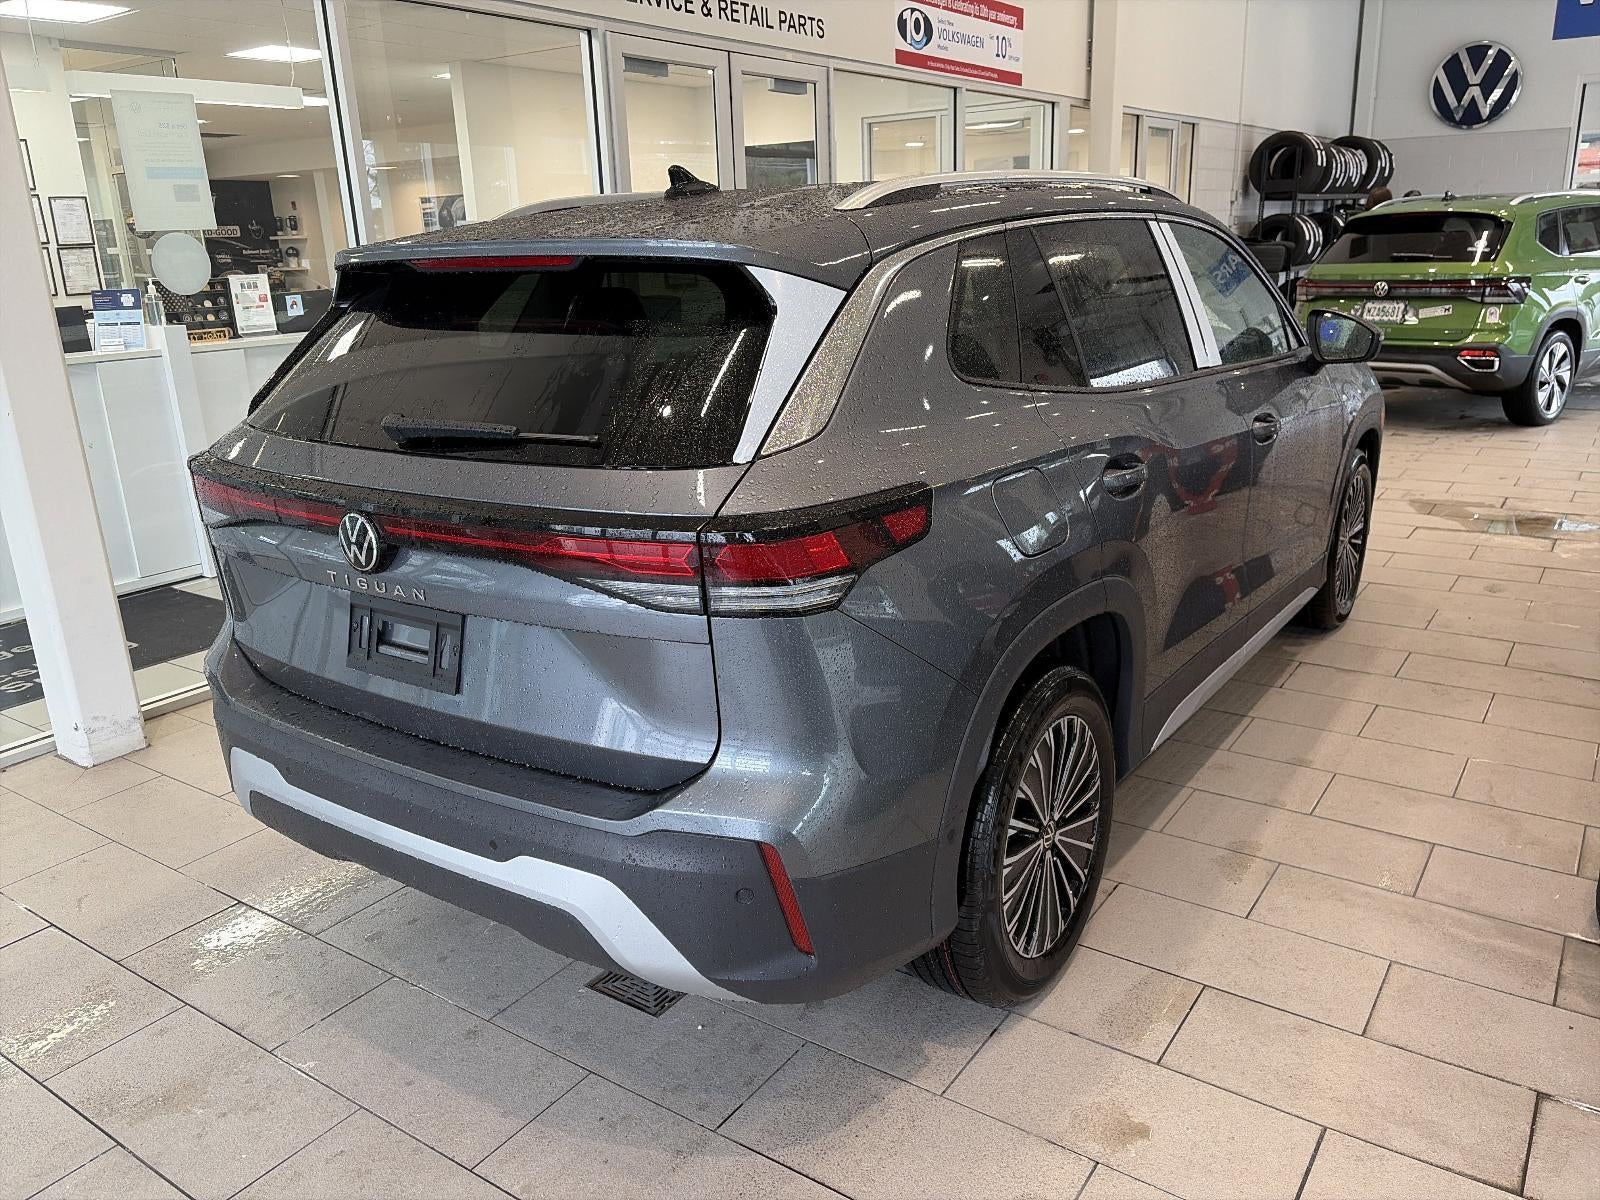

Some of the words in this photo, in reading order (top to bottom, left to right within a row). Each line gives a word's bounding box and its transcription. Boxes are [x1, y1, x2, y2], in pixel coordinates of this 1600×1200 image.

[700, 0, 713, 18] &
[718, 1, 775, 30] RETAIL
[779, 10, 826, 39] PARTS
[902, 9, 925, 44] 10
[937, 26, 985, 49] VOLKSWAGEN
[326, 569, 426, 601] TIGUAN
